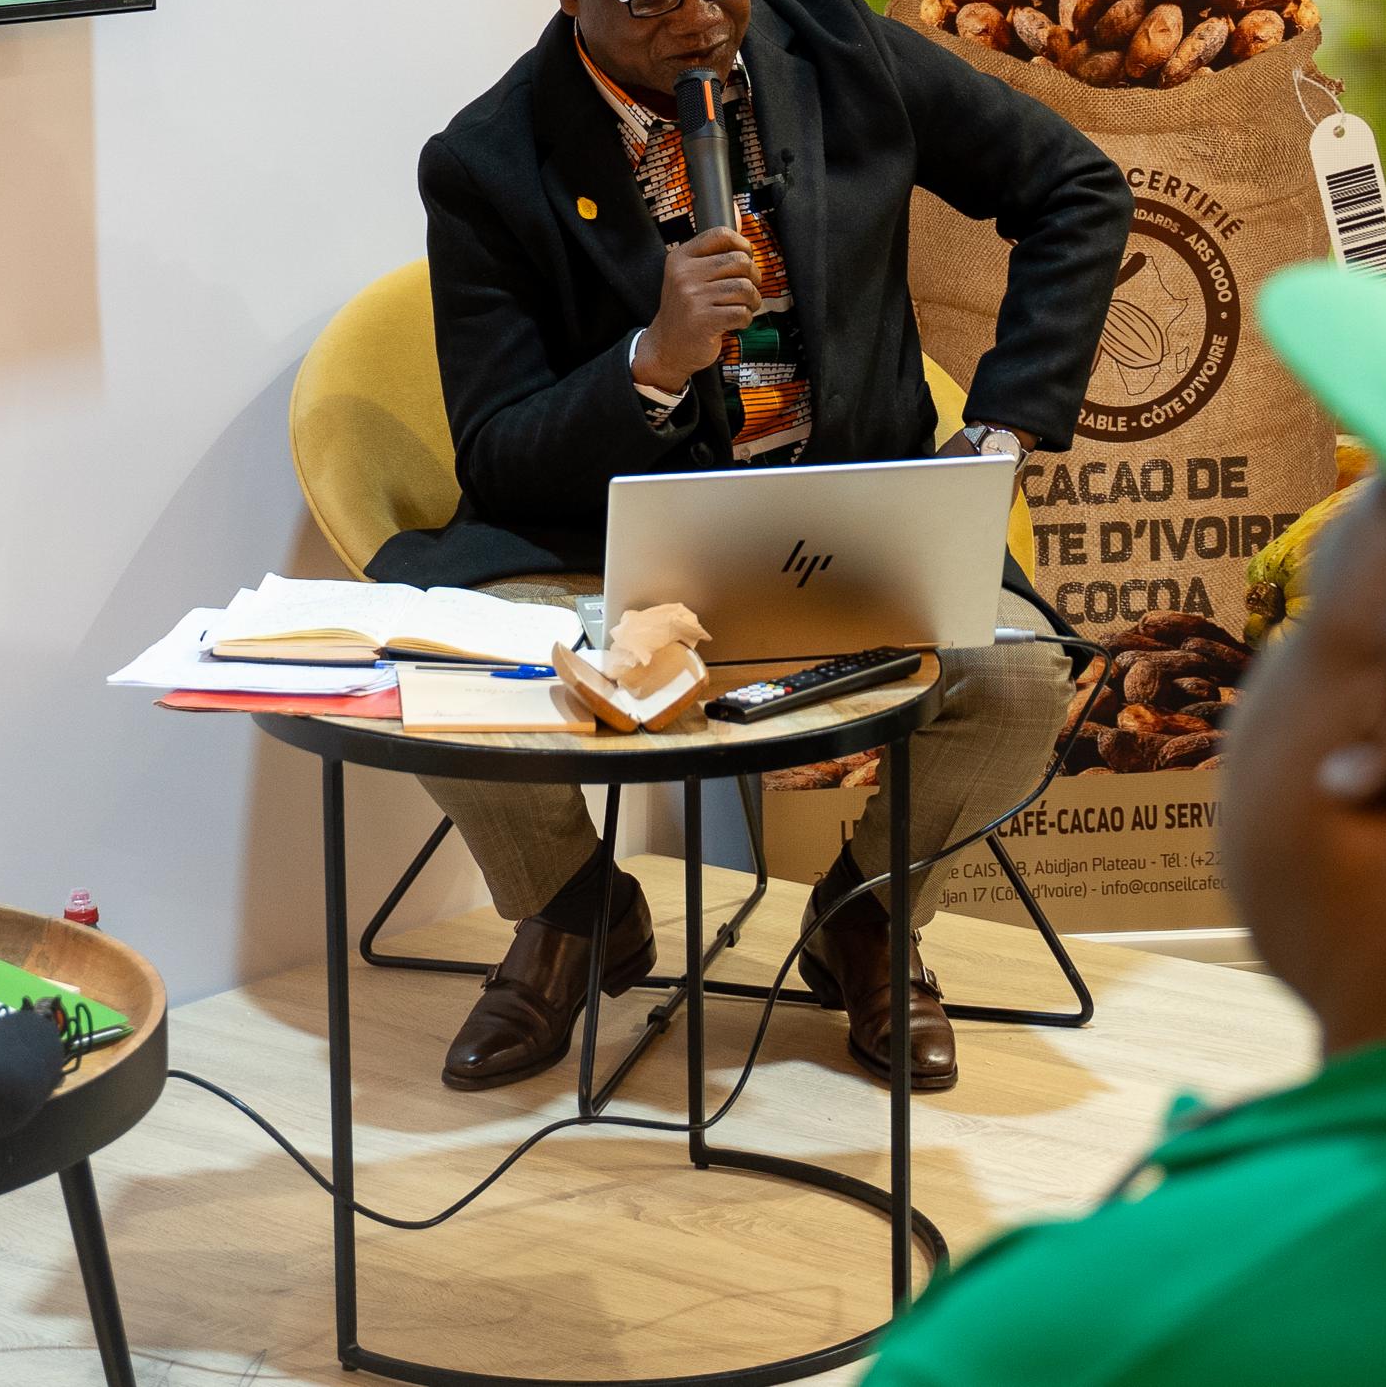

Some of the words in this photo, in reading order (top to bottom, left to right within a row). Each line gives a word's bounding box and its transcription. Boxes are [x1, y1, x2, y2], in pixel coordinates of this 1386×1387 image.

[1126, 166, 1245, 241] CERTIFIÉ
[1184, 234, 1215, 263] ARS
[1209, 259, 1233, 303] 1000
[1077, 408, 1128, 432] RABLE
[1139, 400, 1185, 429] CÔTE
[1021, 458, 1175, 508] CACAO
[1186, 455, 1249, 500] DE
[780, 539, 834, 589] hp
[1033, 522, 1088, 567] TE
[1055, 576, 1214, 625] COCOA
[1131, 804, 1158, 831] AU
[1164, 801, 1222, 829] SERV
[963, 860, 1031, 879] CAISTB,
[1034, 857, 1088, 878] Abidjan
[1092, 857, 1147, 874] Plateau
[972, 887, 987, 902] 17
